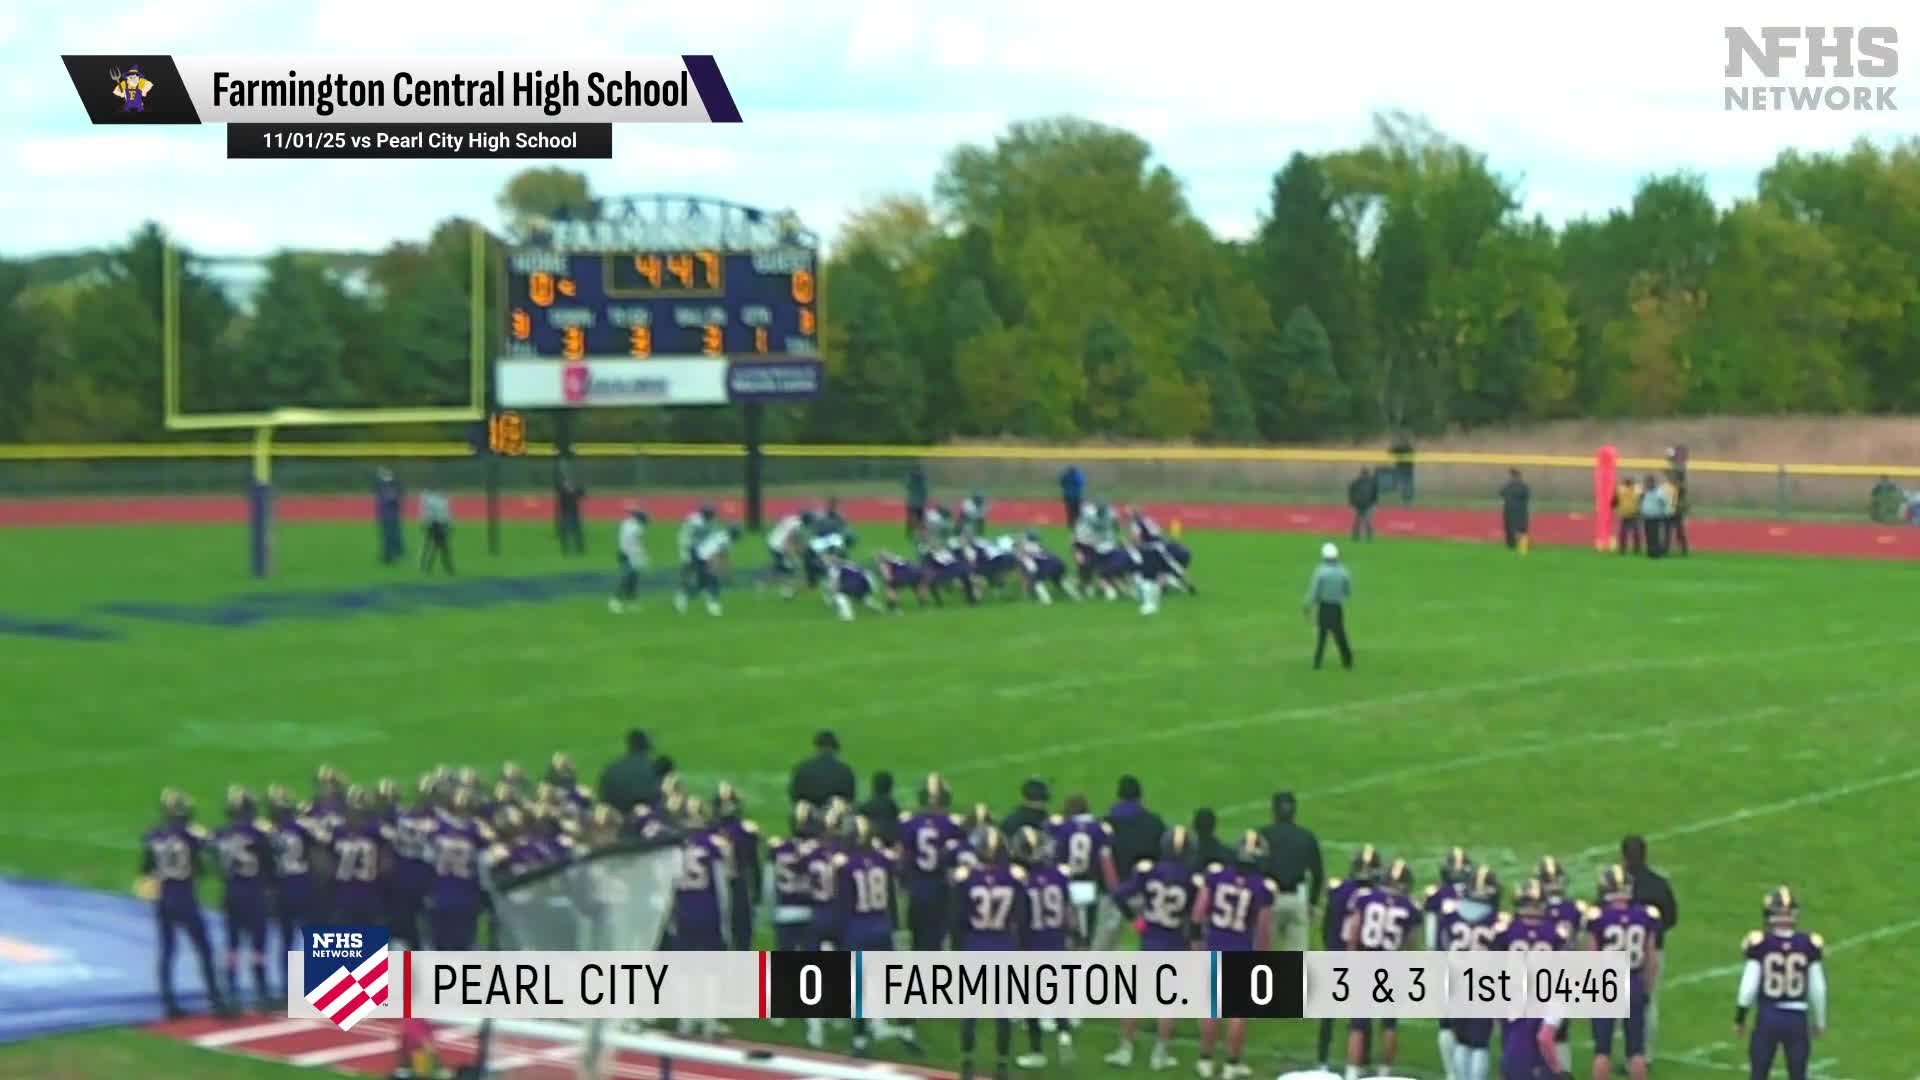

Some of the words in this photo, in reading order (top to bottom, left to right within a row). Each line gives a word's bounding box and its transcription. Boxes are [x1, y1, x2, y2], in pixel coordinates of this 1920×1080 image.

[915, 827, 940, 872] 5
[851, 866, 889, 913] 18
[968, 884, 1016, 931] 37
[1027, 885, 1065, 931] 19
[1144, 879, 1188, 929] 32
[1211, 883, 1252, 932] 51
[1360, 902, 1409, 950] 85
[1763, 953, 1808, 998] 66
